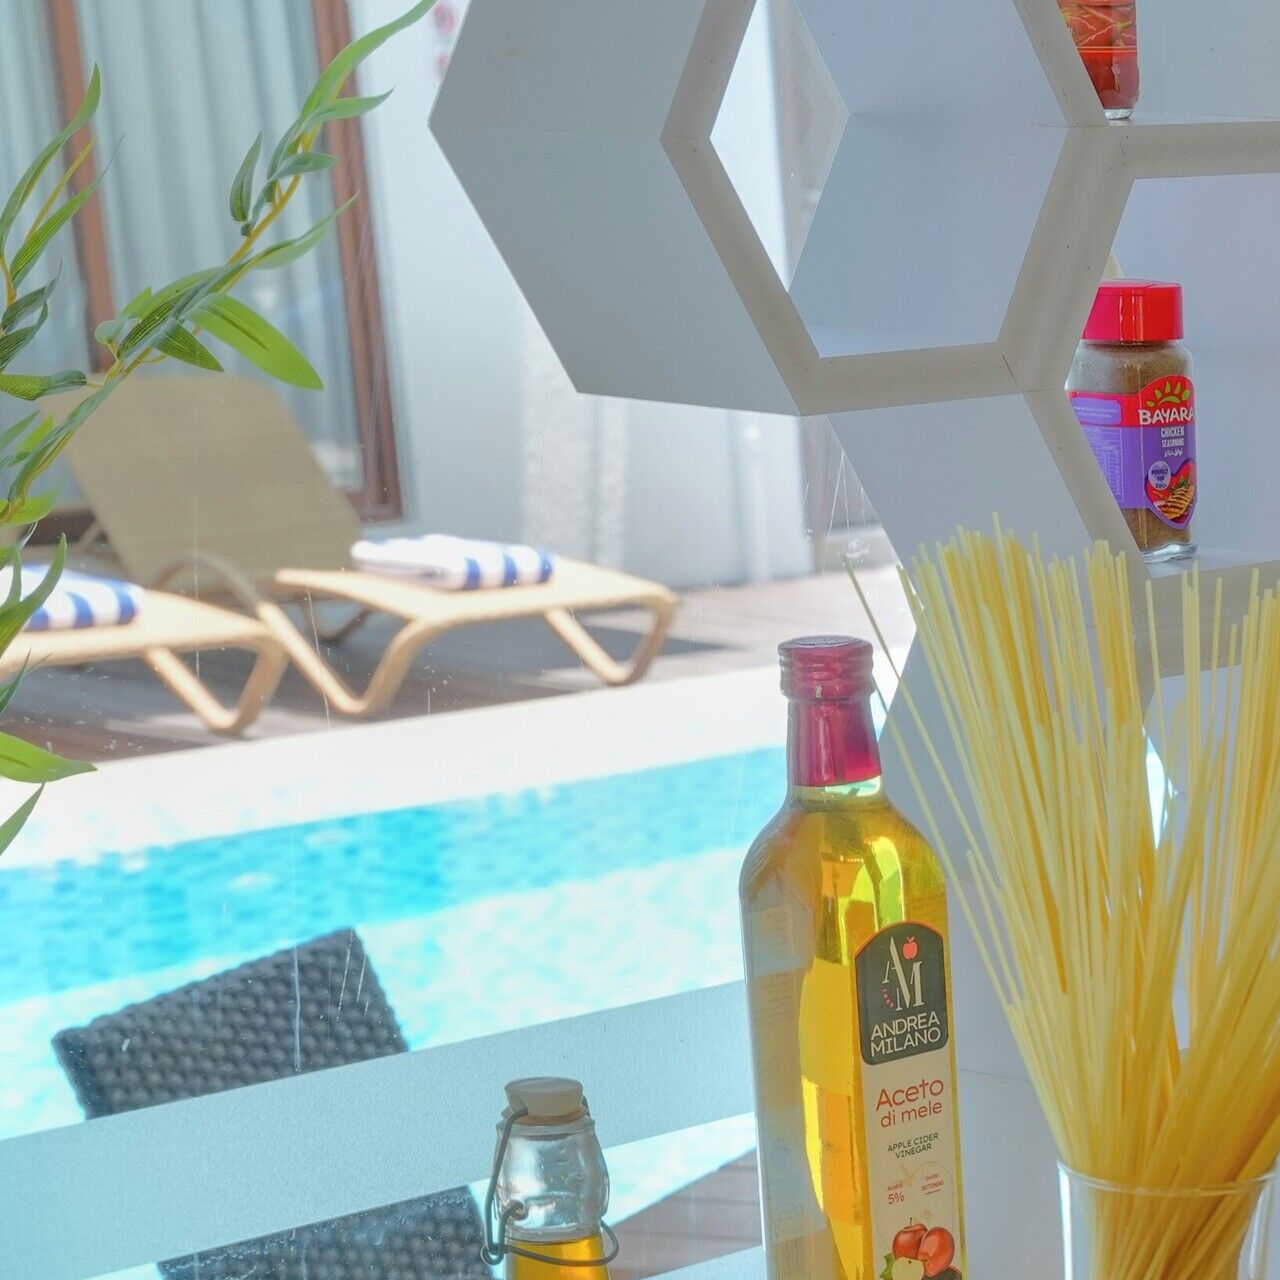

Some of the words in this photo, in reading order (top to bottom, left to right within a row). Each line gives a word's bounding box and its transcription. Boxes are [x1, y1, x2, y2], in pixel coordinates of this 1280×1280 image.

[1138, 407, 1195, 425] BAYARA
[1161, 427, 1184, 438] CHICKEN
[871, 1011, 940, 1040] ANDREA
[871, 1027, 941, 1057] MILANO
[876, 1079, 944, 1111] Aceto
[880, 1110, 896, 1128] di
[901, 1101, 943, 1123] mele
[887, 1139, 912, 1152] APPLE
[913, 1132, 939, 1145] CIDER
[895, 1143, 932, 1159] VINEGAR
[888, 1191, 904, 1205] 5%
